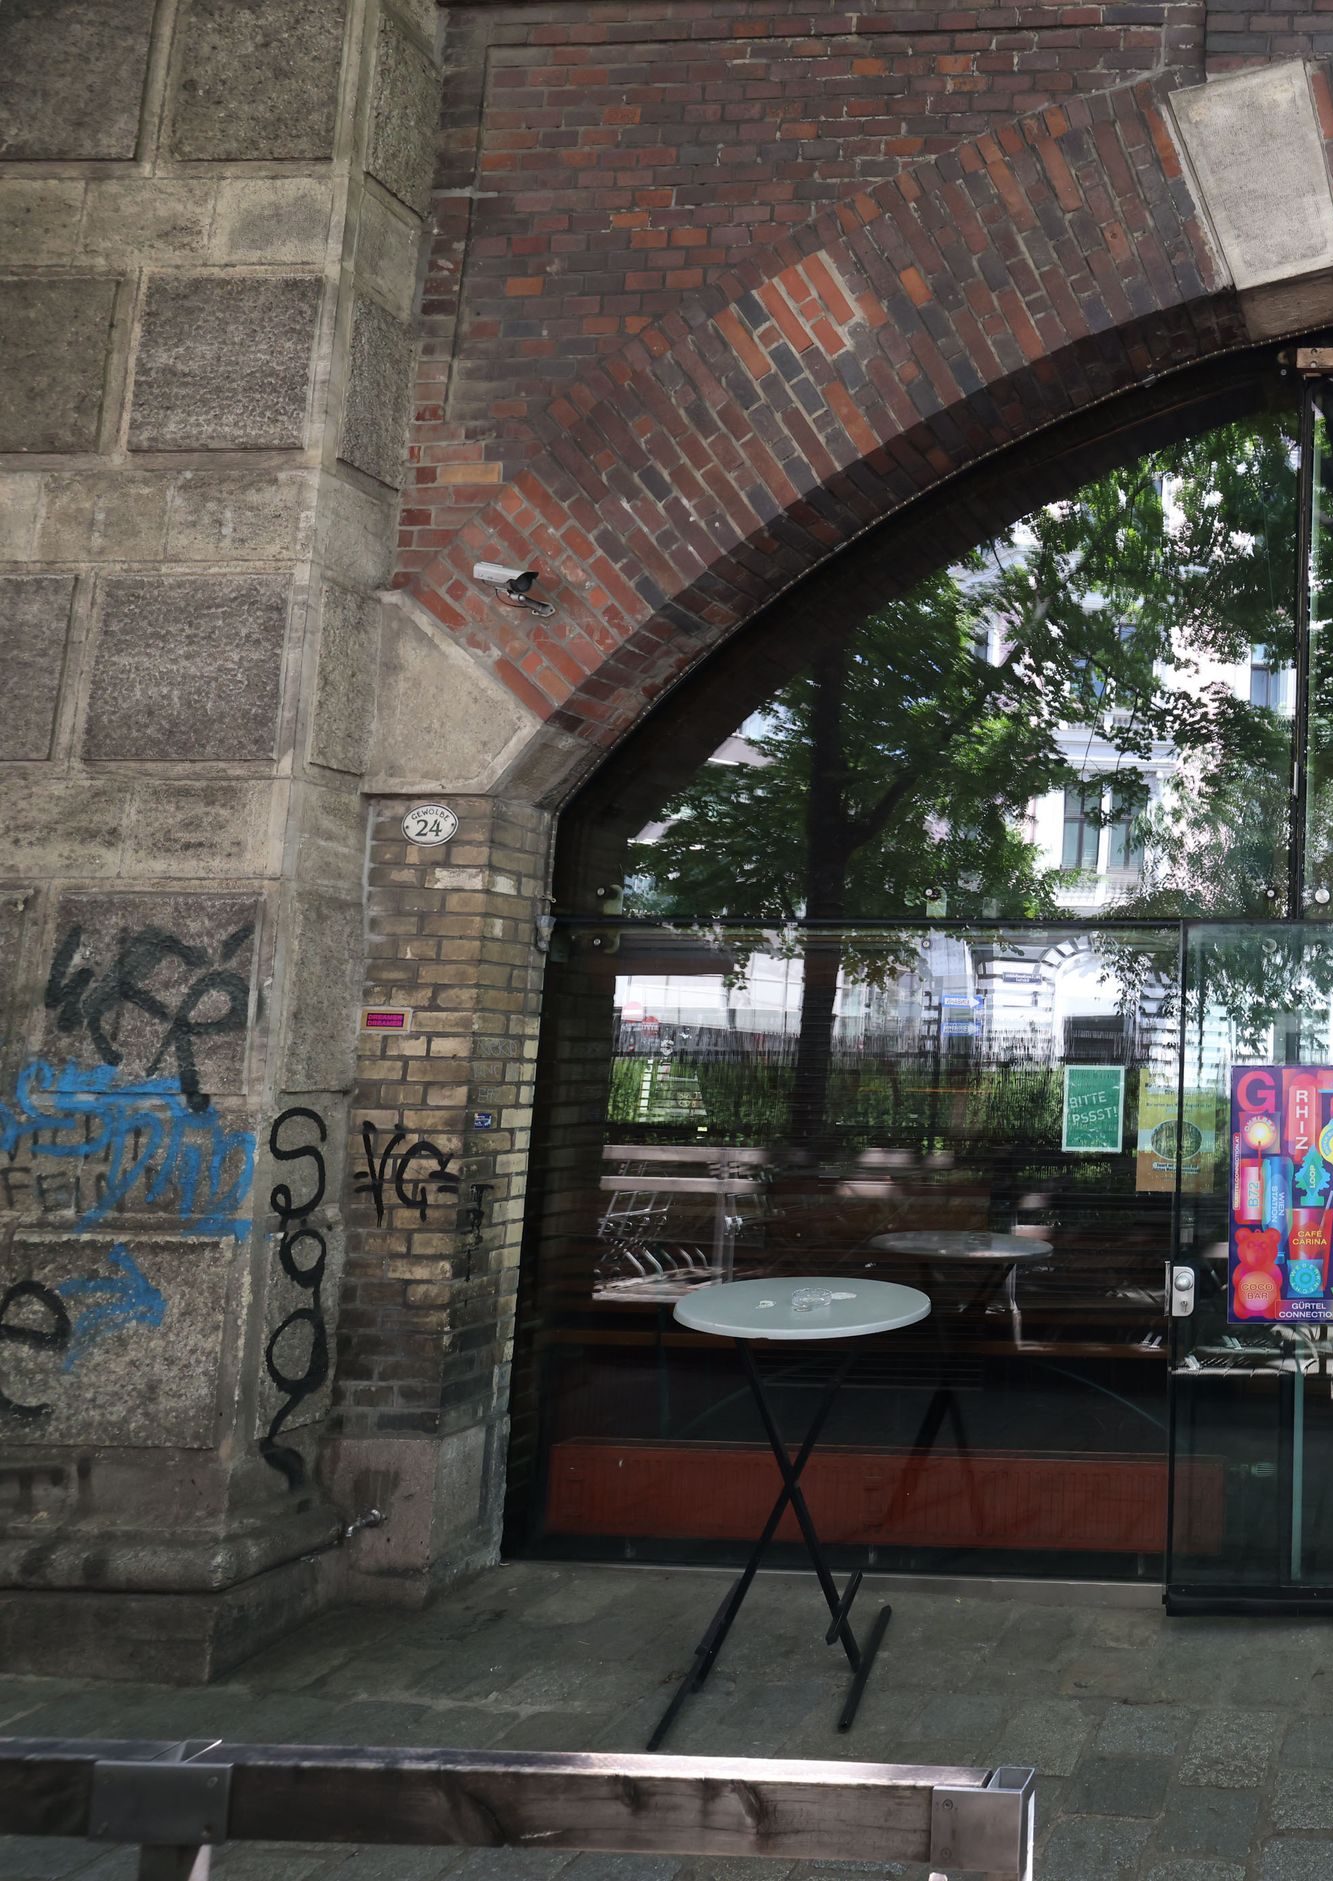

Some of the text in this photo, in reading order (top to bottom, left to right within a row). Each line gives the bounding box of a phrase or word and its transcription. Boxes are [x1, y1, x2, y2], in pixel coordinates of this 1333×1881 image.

[411, 807, 450, 822] GEWÖLBE
[415, 818, 443, 837] 24
[1069, 1090, 1107, 1110] BITTE
[1236, 1070, 1277, 1114] G
[1295, 1089, 1309, 1150] RHIZ
[1247, 1182, 1259, 1207] B72
[1271, 1185, 1279, 1223] STATION
[1292, 1238, 1328, 1246] CARINA
[1241, 1283, 1273, 1291] COCO
[1247, 1292, 1268, 1300] BAR
[1291, 1301, 1327, 1310] GÜRTEL
